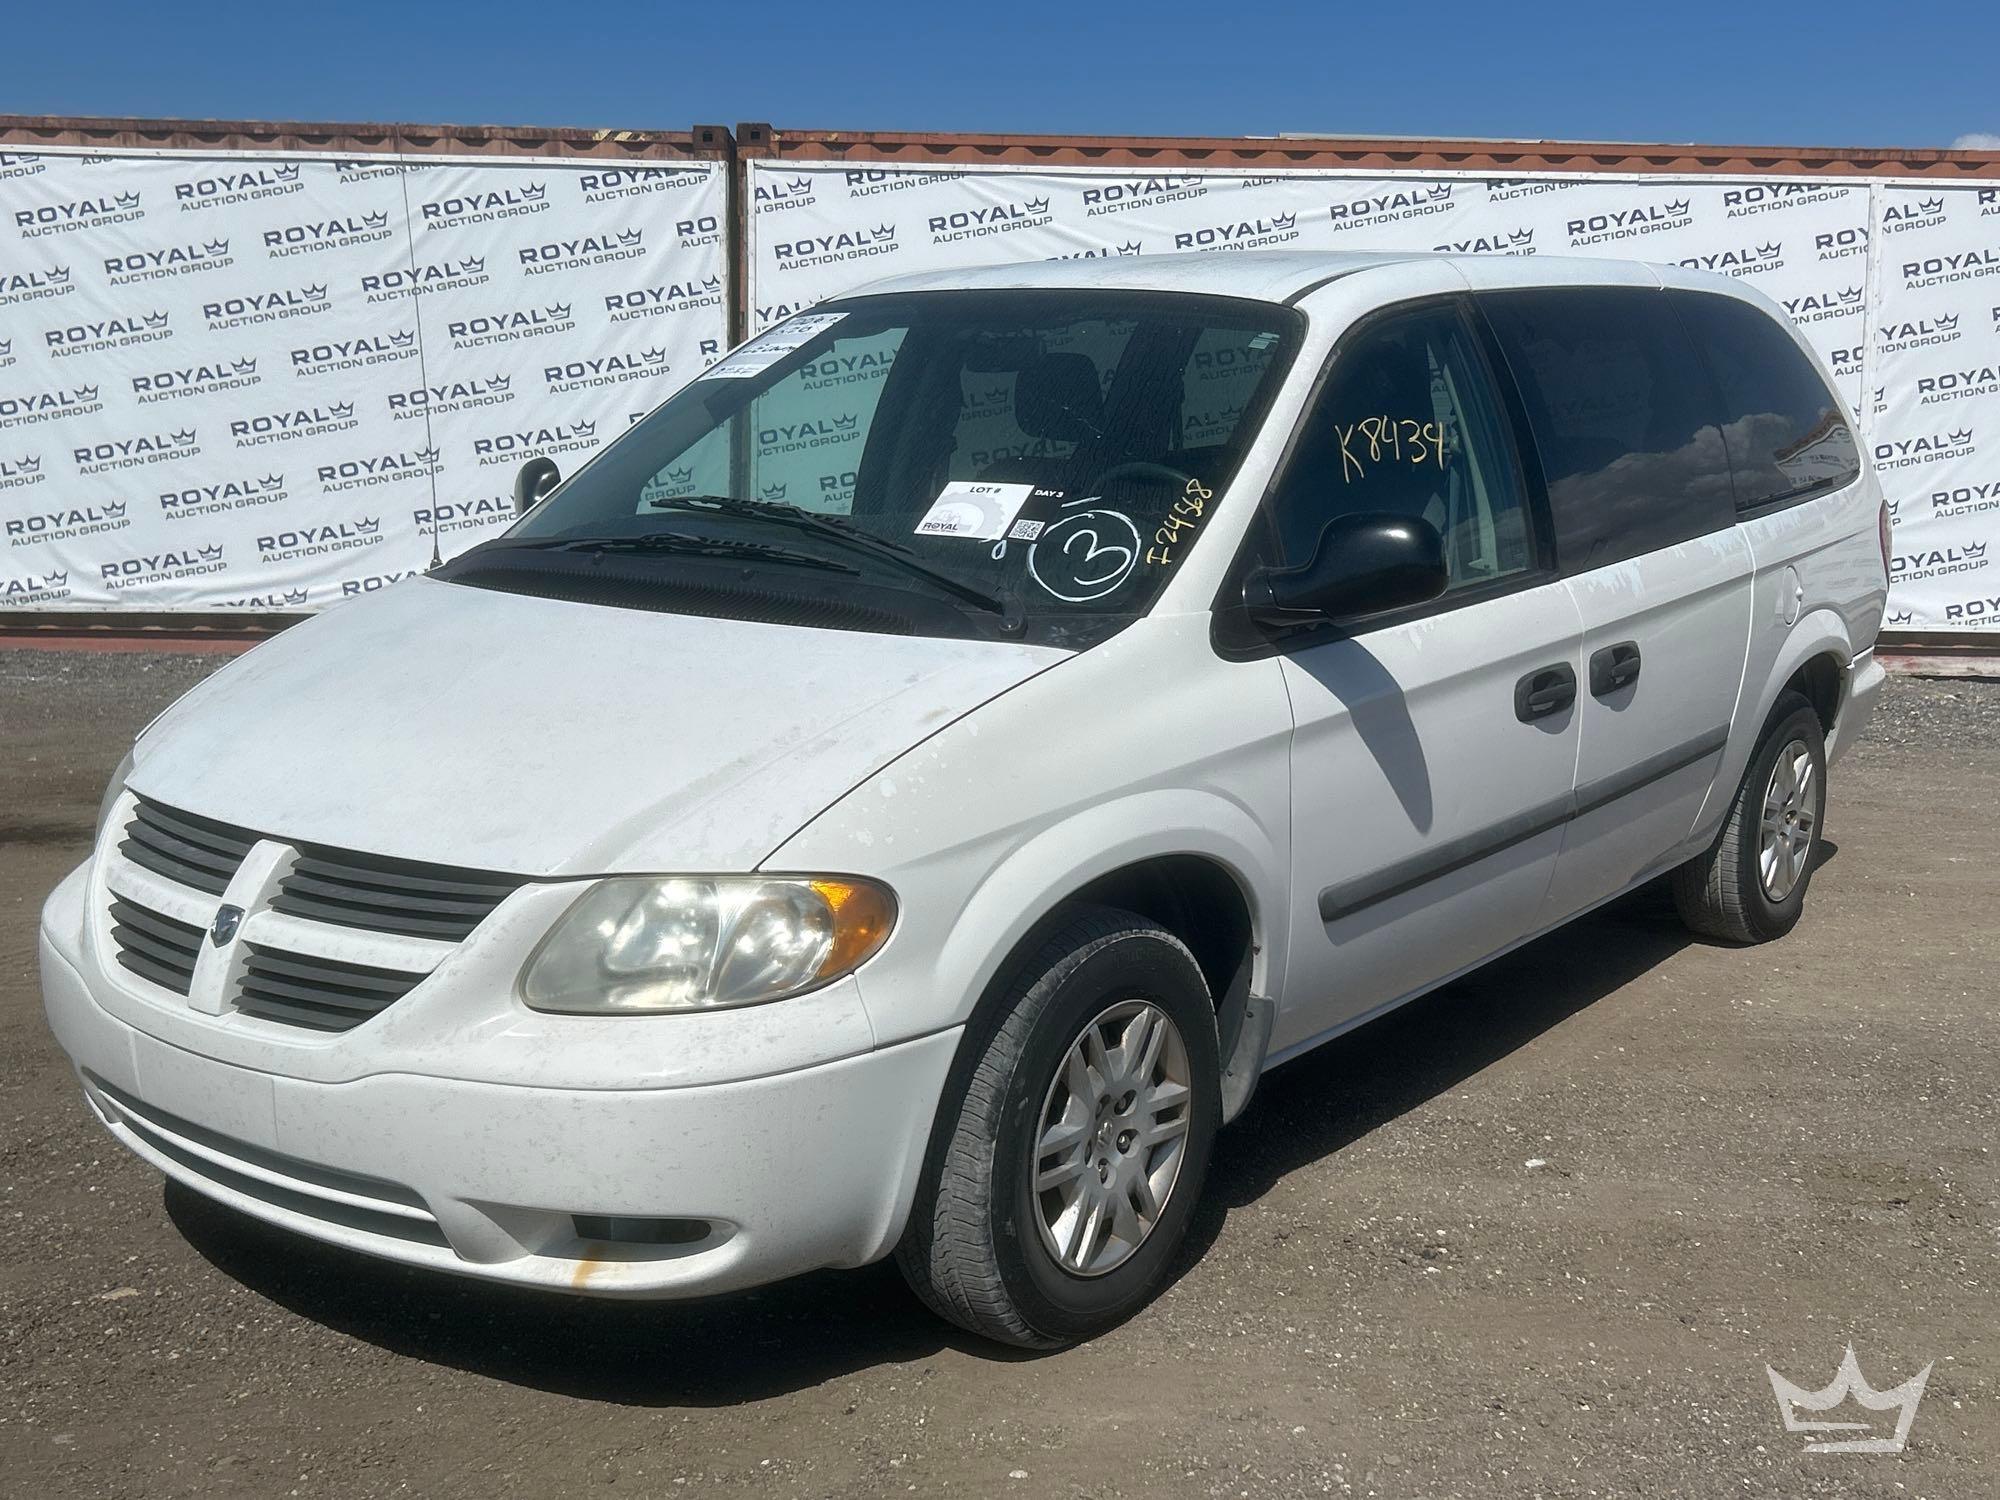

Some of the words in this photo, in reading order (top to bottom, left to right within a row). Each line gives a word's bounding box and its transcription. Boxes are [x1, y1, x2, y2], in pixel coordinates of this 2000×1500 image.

[0, 164, 46, 180] ROUP
[175, 170, 276, 200] ROYAL
[340, 165, 406, 184] AUCTION
[181, 192, 248, 212] AUCTION
[250, 182, 304, 200] GROUP
[585, 184, 652, 204] AUCTION
[654, 174, 708, 191] GROUP
[849, 178, 916, 198] AUCTION
[1082, 177, 1179, 206] ROYAL
[1087, 197, 1153, 217] AUCTION
[1155, 188, 1208, 204] GROUP
[1489, 183, 1555, 203] AUCTION
[15, 198, 116, 227] ROYAL
[421, 190, 522, 220] ROYAL
[427, 211, 495, 231] AUCTION
[497, 202, 550, 219] GROUP
[763, 196, 816, 213] GROUP
[928, 204, 1026, 233] ROYAL
[1329, 190, 1427, 220] ROYAL
[1333, 212, 1400, 232] AUCTION
[1402, 202, 1455, 219] GROUP
[1727, 198, 1794, 219] AUCTION
[1796, 189, 1849, 206] GROUP
[22, 220, 89, 239] AUCTION
[91, 210, 145, 227] GROUP
[263, 217, 364, 247] ROYAL
[933, 225, 998, 245] AUCTION
[1001, 216, 1053, 232] GROUP
[1174, 219, 1272, 250] ROYAL
[1567, 206, 1664, 236] ROYAL
[1570, 228, 1637, 248] AUCTION
[1640, 219, 1693, 235] GROUP
[1894, 215, 1947, 233] GROUP
[269, 239, 336, 259] AUCTION
[338, 230, 392, 247] GROUP
[519, 235, 618, 265] ROYAL
[681, 234, 720, 249] AUCT
[774, 231, 871, 260] ROYAL
[1247, 232, 1299, 248] GROUP
[1433, 235, 1509, 253] YAL
[1815, 228, 1869, 250] ROY
[1818, 243, 1869, 261] AUCTI
[104, 245, 205, 275] ROYAL
[110, 267, 178, 286] AUCTION
[180, 257, 234, 274] GROUP
[524, 256, 591, 277] AUCTION
[593, 247, 646, 264] GROUP
[779, 252, 845, 271] AUCTION
[847, 243, 899, 259] GROUP
[1668, 249, 1757, 270] OYAL
[1731, 260, 1784, 277] GROUP
[1902, 249, 1999, 279] ROYAL
[361, 262, 461, 293] ROYAL
[367, 284, 434, 304] AUCTION
[436, 275, 489, 291] GROUP
[1906, 270, 1972, 290] AUCTION
[1974, 265, 2000, 278] GRO
[22, 285, 75, 301] GROUP
[203, 290, 303, 320] ROYAL
[605, 282, 703, 312] ROYAL
[1781, 293, 1838, 314] YAL
[209, 312, 276, 331] AUCTION
[278, 303, 332, 319] GROUP
[448, 309, 547, 338] ROYAL
[610, 303, 678, 323] AUCTION
[681, 296, 722, 311] GROU
[1812, 305, 1865, 322] GROUP
[45, 317, 144, 347] ROYAL
[51, 339, 117, 358] AUCTION
[119, 329, 173, 346] GROUP
[453, 331, 520, 350] AUCTION
[523, 321, 575, 338] GROUP
[1880, 320, 1934, 341] YAL
[1909, 332, 1961, 349] GROUP
[290, 336, 390, 366] ROYAL
[296, 358, 363, 378] AUCTION
[365, 349, 419, 365] GROUP
[800, 350, 892, 380] ROYAL
[1195, 348, 1272, 368] ROYA
[132, 364, 233, 393] ROYAL
[544, 354, 645, 383] ROYAL
[549, 375, 616, 394] AUCTION
[618, 365, 670, 382] GROUP
[803, 372, 866, 391] AUCTION
[1917, 366, 2000, 394] ROYA
[0, 391, 74, 416] OYAL
[138, 385, 205, 405] AUCTION
[207, 376, 261, 392] GROUP
[387, 381, 487, 410] ROYAL
[1920, 386, 1986, 405] AUCTION
[0, 412, 49, 429] CTION
[51, 403, 103, 421] GROUP
[393, 401, 460, 421] AUCTION
[462, 392, 515, 409] GROUP
[230, 408, 332, 437] ROYAL
[236, 429, 303, 448] AUCTION
[305, 420, 359, 436] GROUP
[760, 420, 833, 445] OYAL
[1198, 424, 1236, 438] GROU
[73, 435, 174, 464] ROYAL
[474, 426, 574, 455] ROYAL
[479, 447, 545, 467] AUCTION
[548, 438, 600, 455] GROUP
[757, 440, 807, 458] UCTION
[810, 431, 861, 448] GROUP
[1875, 435, 1949, 459] OYAL
[80, 456, 145, 476] AUCTION
[147, 447, 201, 463] GROUP
[317, 453, 418, 482] ROYAL
[1873, 456, 1921, 472] CTION
[1924, 446, 1975, 462] GROUP
[0, 474, 45, 490] ROUP
[323, 474, 390, 494] AUCTION
[391, 465, 445, 481] GROUP
[1034, 489, 1055, 497] DAY
[160, 480, 260, 510] ROYAL
[165, 501, 232, 520] AUCTION
[235, 492, 288, 509] GROUP
[1931, 483, 2000, 508] ROY
[1935, 500, 2000, 519] AUCTION
[5, 507, 106, 536] ROYAL
[413, 497, 512, 525] ROYAL
[418, 517, 485, 537] AUCTION
[487, 511, 517, 526] GRO
[11, 528, 77, 547] AUCTION
[79, 519, 131, 536] GROUP
[257, 523, 356, 552] ROYAL
[923, 522, 958, 531] ROYAL
[262, 544, 329, 563] AUCTION
[331, 535, 384, 551] GROUP
[1063, 529, 1132, 586] 3
[1891, 548, 1961, 572] OYAL
[101, 550, 201, 579] ROYAL
[106, 571, 172, 590] AUCTION
[175, 562, 227, 578] GROUP
[1890, 565, 1935, 584] CTION
[1937, 559, 1989, 576] GROUP
[19, 589, 72, 605] GROUP
[342, 571, 416, 596] ROY
